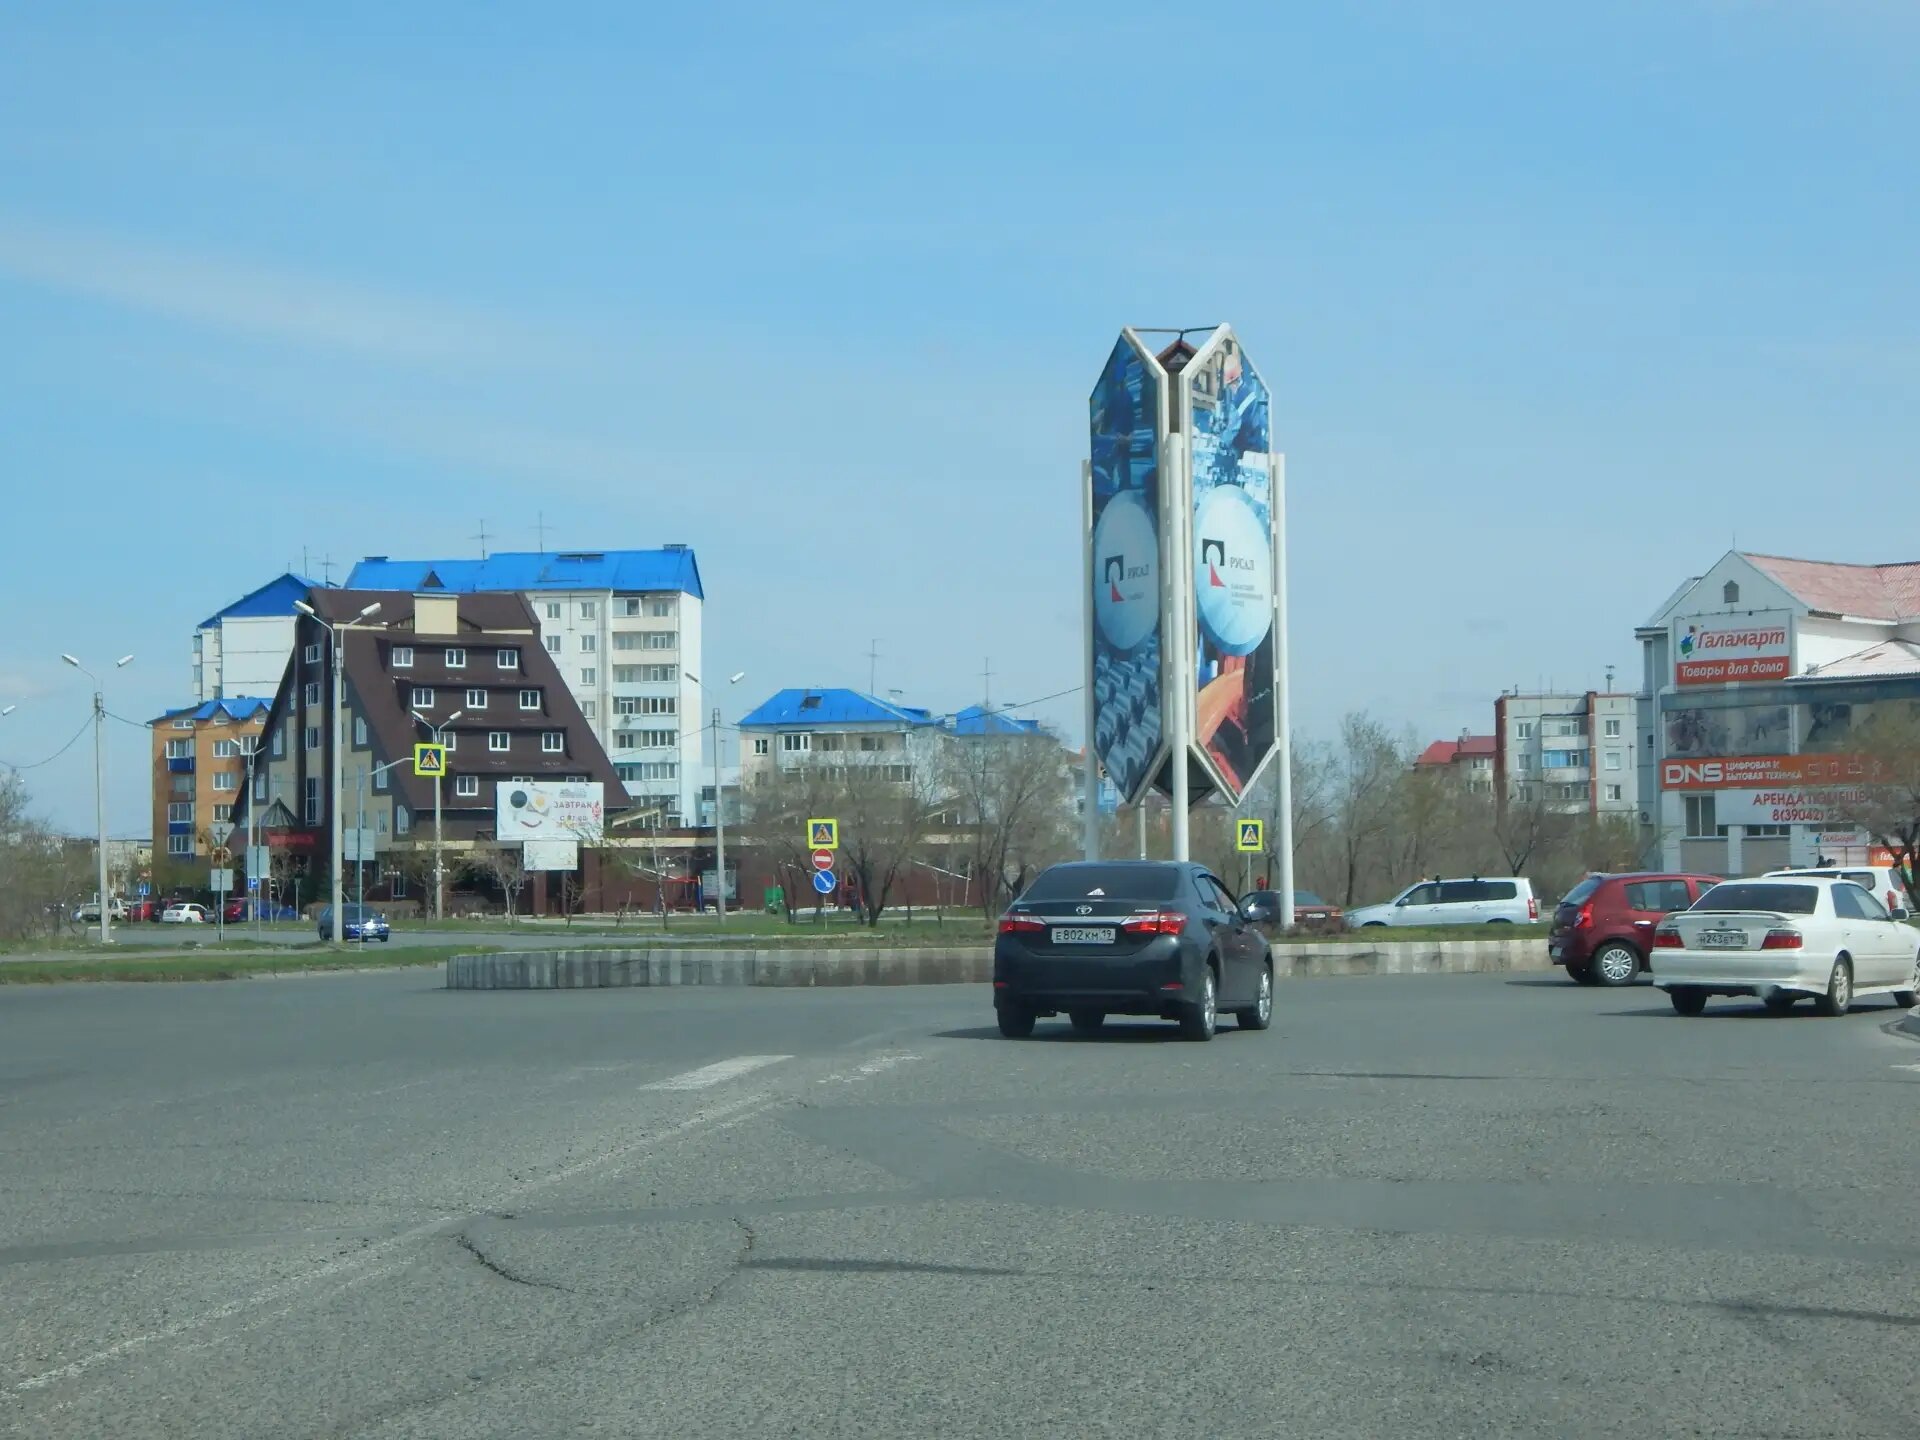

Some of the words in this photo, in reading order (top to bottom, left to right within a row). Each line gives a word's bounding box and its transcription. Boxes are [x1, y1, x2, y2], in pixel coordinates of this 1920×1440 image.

[1230, 556, 1255, 570] РУСАЛ
[1697, 630, 1786, 652] Галамарт
[1681, 664, 1725, 679] Товары
[1727, 662, 1750, 676] для
[1751, 660, 1785, 673] дома
[1665, 762, 1723, 784] DNS
[1752, 792, 1805, 807] АРЕНДА
